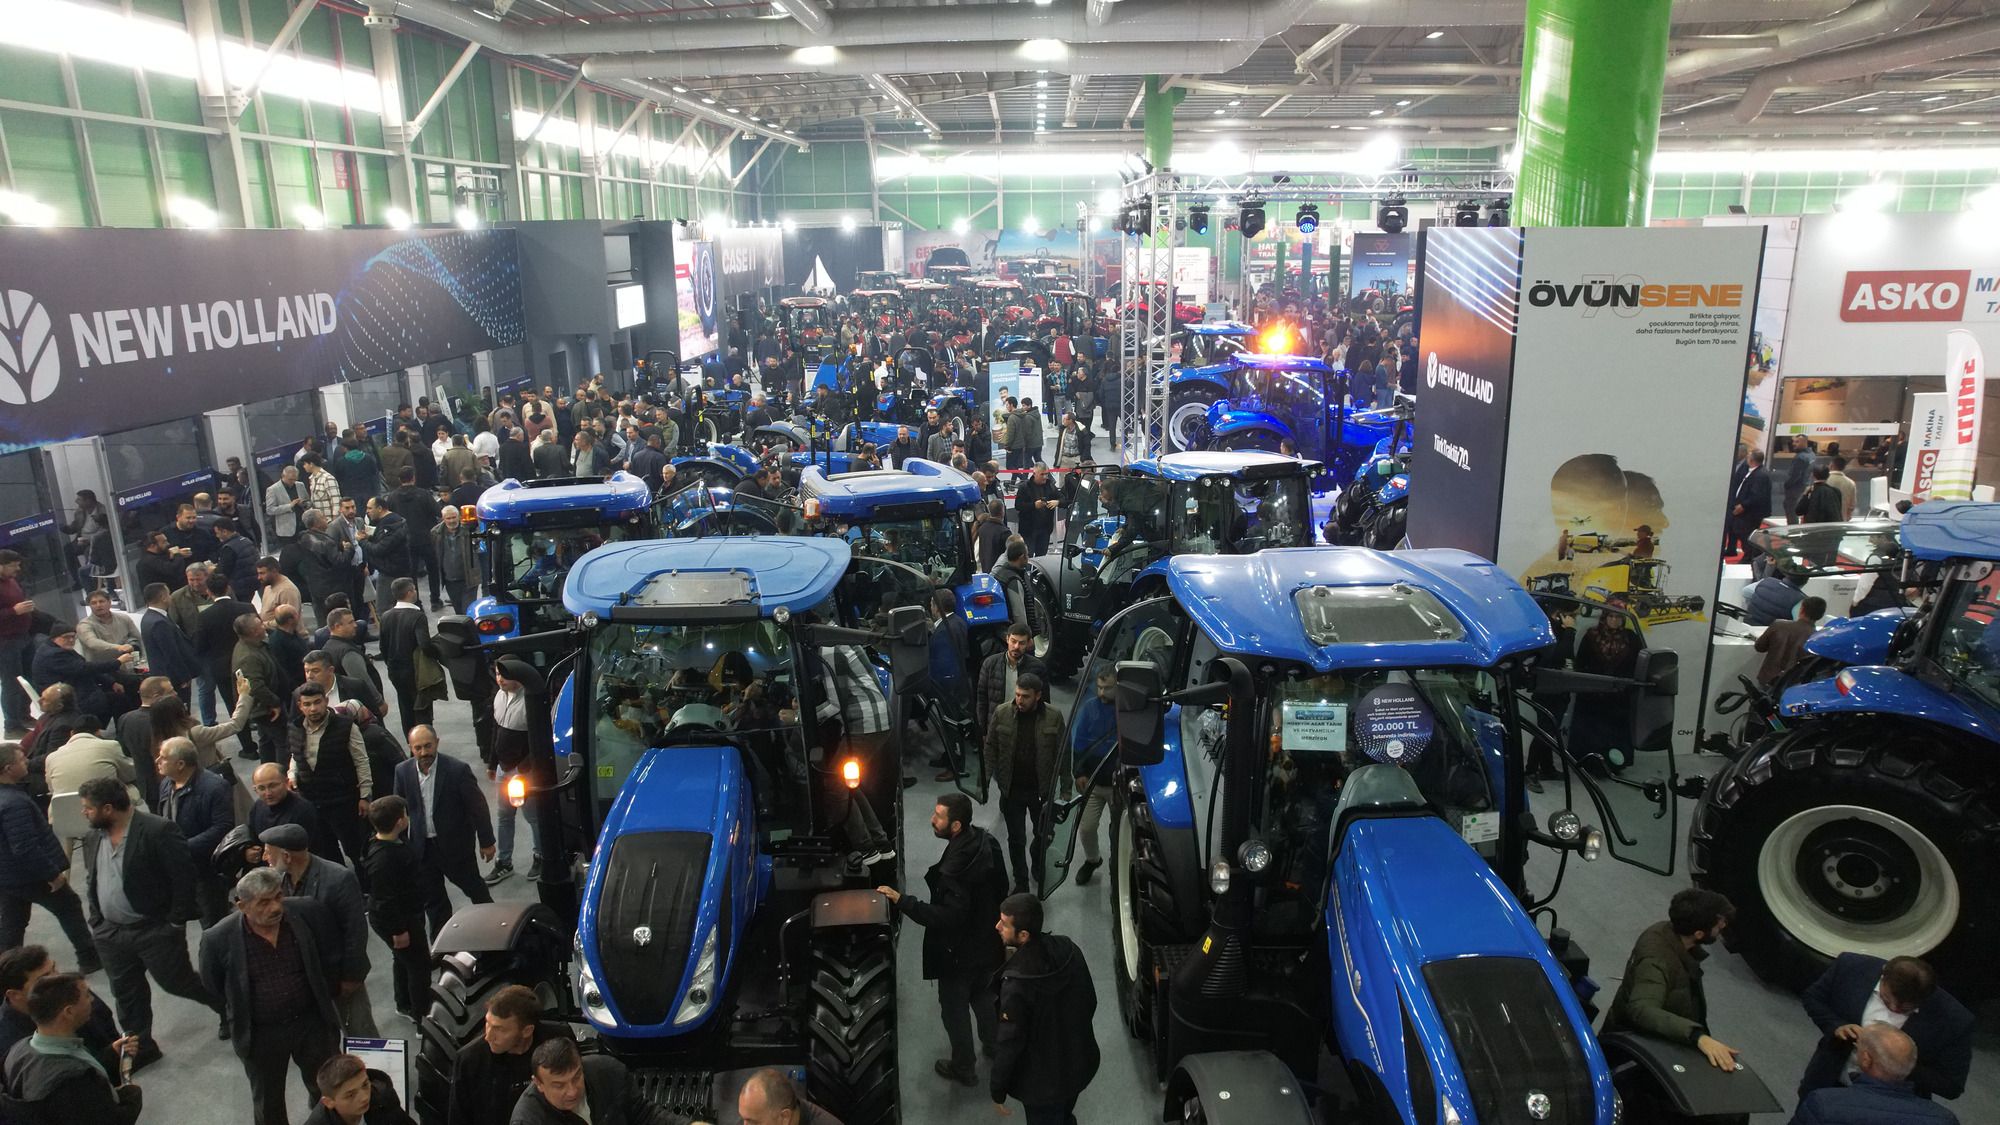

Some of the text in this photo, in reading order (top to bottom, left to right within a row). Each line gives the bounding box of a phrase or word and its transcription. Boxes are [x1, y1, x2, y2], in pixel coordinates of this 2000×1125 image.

[722, 247, 748, 274] CASE
[1848, 282, 1960, 310] ASKO
[69, 293, 337, 368] NEW HOLLAND
[1675, 338, 1696, 346] Bugün
[1437, 363, 1494, 404] NEW HOLLAND
[1924, 409, 1936, 447] MAKİNA
[1371, 721, 1418, 732] 20.000 TL
